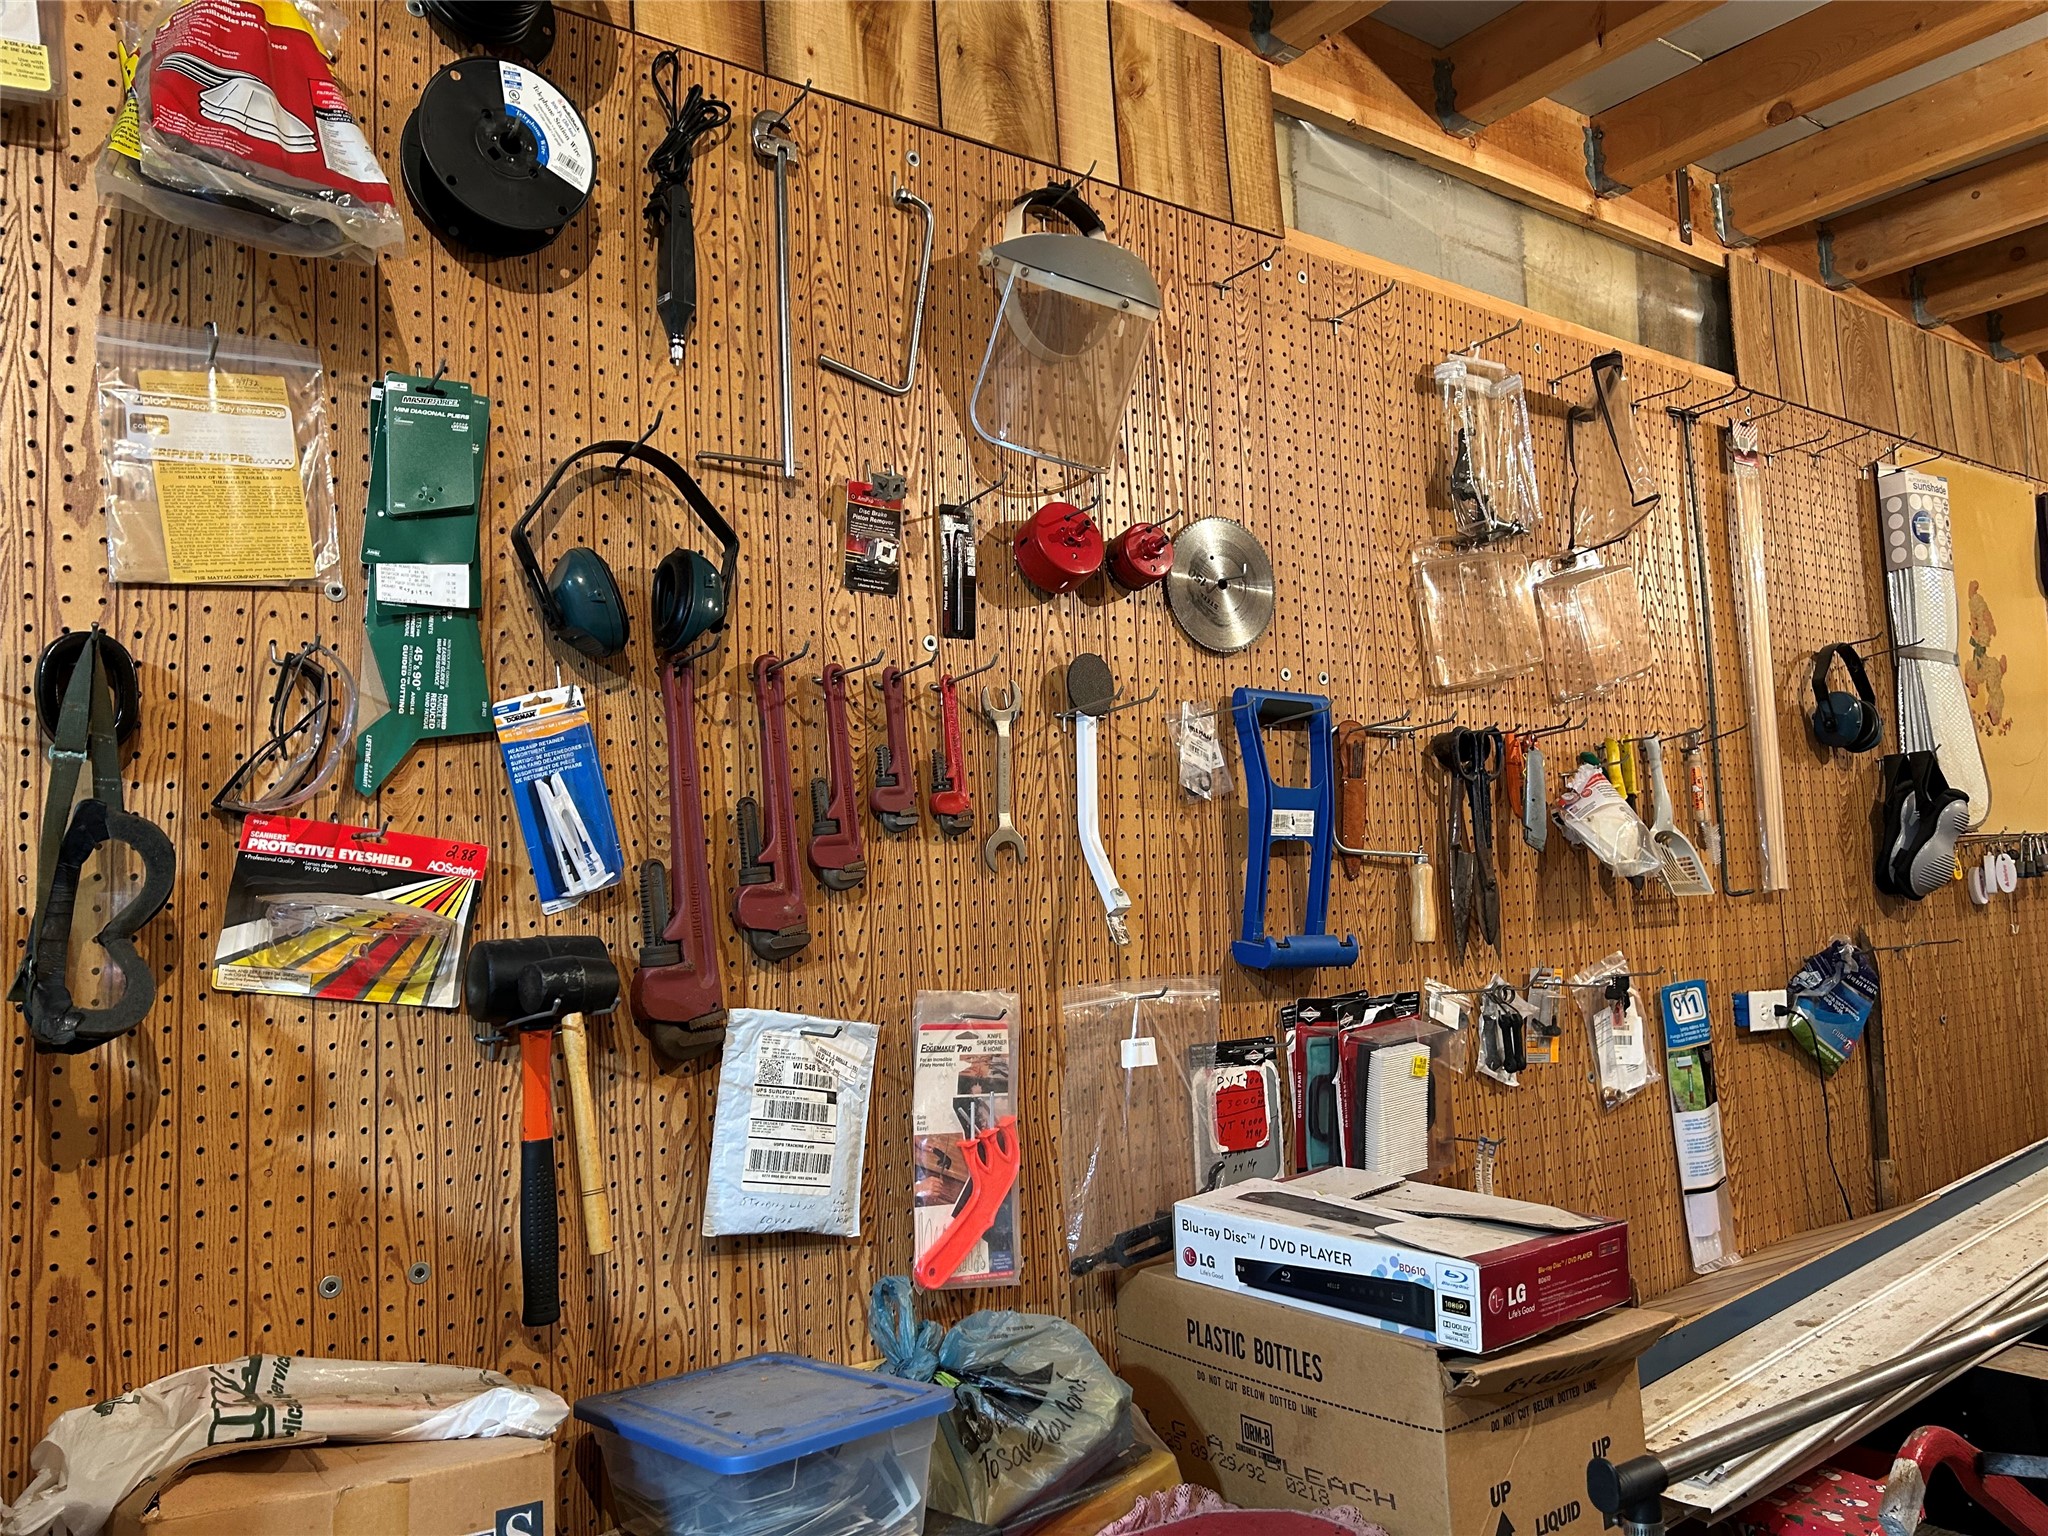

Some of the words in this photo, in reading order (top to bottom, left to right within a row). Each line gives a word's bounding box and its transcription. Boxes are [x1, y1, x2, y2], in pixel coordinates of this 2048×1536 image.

[515, 109, 542, 138] Telephone
[532, 84, 554, 117] Telephone
[554, 117, 570, 140] Station
[570, 140, 582, 158] Wire
[236, 406, 264, 416] freezer
[265, 408, 286, 418] bags
[393, 406, 408, 414] MINI
[410, 408, 446, 418] DIAGONAL
[447, 412, 470, 420] PLIERS
[1912, 482, 1946, 496] sunshade
[852, 514, 869, 522] Piston
[869, 516, 894, 526] Remover
[858, 507, 871, 515] Disc
[872, 510, 888, 518] Brake
[400, 644, 408, 676] GUIDED
[398, 678, 407, 714] CUTTING
[428, 692, 436, 729] REDUCED
[502, 710, 538, 724] DORMAN
[576, 699, 582, 707] 4
[364, 734, 372, 762] LIFETIME
[508, 744, 538, 755] HEADLAMP
[539, 736, 564, 748] RETAINER
[509, 747, 546, 760] ASSORTMENT
[564, 762, 582, 772] PHARE
[247, 838, 334, 858] PROTECTIVE
[338, 848, 412, 868] EYESHIELD
[278, 857, 296, 866] Quality
[446, 844, 478, 862] 2.88
[305, 860, 320, 868] Lenses
[321, 862, 338, 870] absorb
[372, 868, 388, 876] Design
[426, 859, 479, 879] AOSafety
[1673, 994, 1698, 1017] 911
[920, 1044, 955, 1053] EDGEMAKER
[957, 1044, 972, 1052] PRO
[793, 1062, 802, 1070] WI
[769, 1088, 796, 1096] SUREPOST
[1182, 1218, 1220, 1242] Blu-ray
[1260, 1235, 1266, 1250] /
[1270, 1238, 1296, 1254] DVD
[1300, 1245, 1352, 1268] PLAYER
[1199, 1253, 1216, 1270] LG
[1568, 1256, 1578, 1264] DVD
[1578, 1250, 1593, 1262] PLAYER
[1212, 1272, 1224, 1280] Good
[1398, 1263, 1426, 1278] BD610
[1508, 1283, 1526, 1307] LG
[1508, 1308, 1522, 1320] Life's
[1522, 1304, 1536, 1316] Good
[1452, 1322, 1472, 1332] DOLBY
[1186, 1318, 1246, 1360] PLASTIC
[1254, 1338, 1323, 1382] BOTTLES
[1196, 1370, 1206, 1381] DO
[1208, 1374, 1222, 1387] NOT
[1225, 1380, 1238, 1392] CUT
[1242, 1384, 1265, 1402] BELOW
[1270, 1394, 1297, 1412] DOTTED
[1300, 1404, 1318, 1418] LINE
[1491, 1420, 1500, 1433] DO
[1503, 1414, 1516, 1428] NOT
[1518, 1408, 1530, 1420] CUT
[1533, 1399, 1554, 1414] BELOW
[1558, 1389, 1580, 1404] DOTTED
[1584, 1379, 1598, 1394] LINE
[1244, 1422, 1270, 1446] ORM-B
[978, 1448, 999, 1488] To
[996, 1430, 1044, 1471] Save
[1034, 1419, 1072, 1444] You
[1592, 1435, 1611, 1459] UP
[1286, 1478, 1330, 1506] 0218
[1490, 1480, 1512, 1508] UP
[1535, 1500, 1581, 1536] LIQUID
